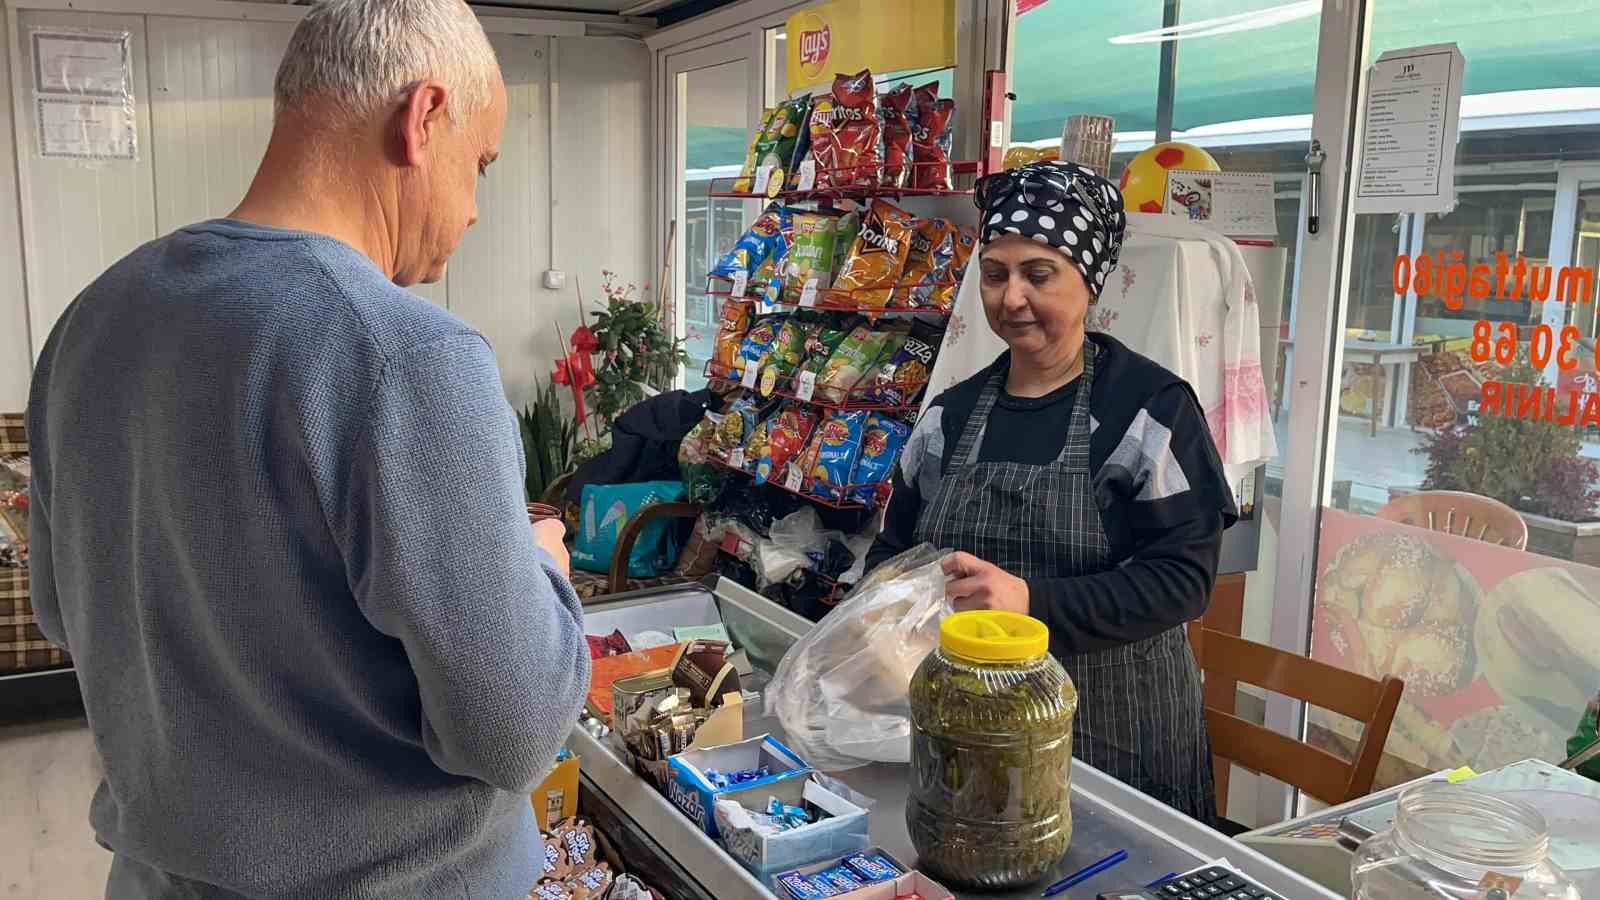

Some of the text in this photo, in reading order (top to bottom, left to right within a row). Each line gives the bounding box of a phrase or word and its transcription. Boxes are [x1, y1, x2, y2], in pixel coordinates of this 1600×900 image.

[801, 30, 828, 64] Lay's
[833, 105, 862, 120] ritos
[904, 337, 932, 364] ezza
